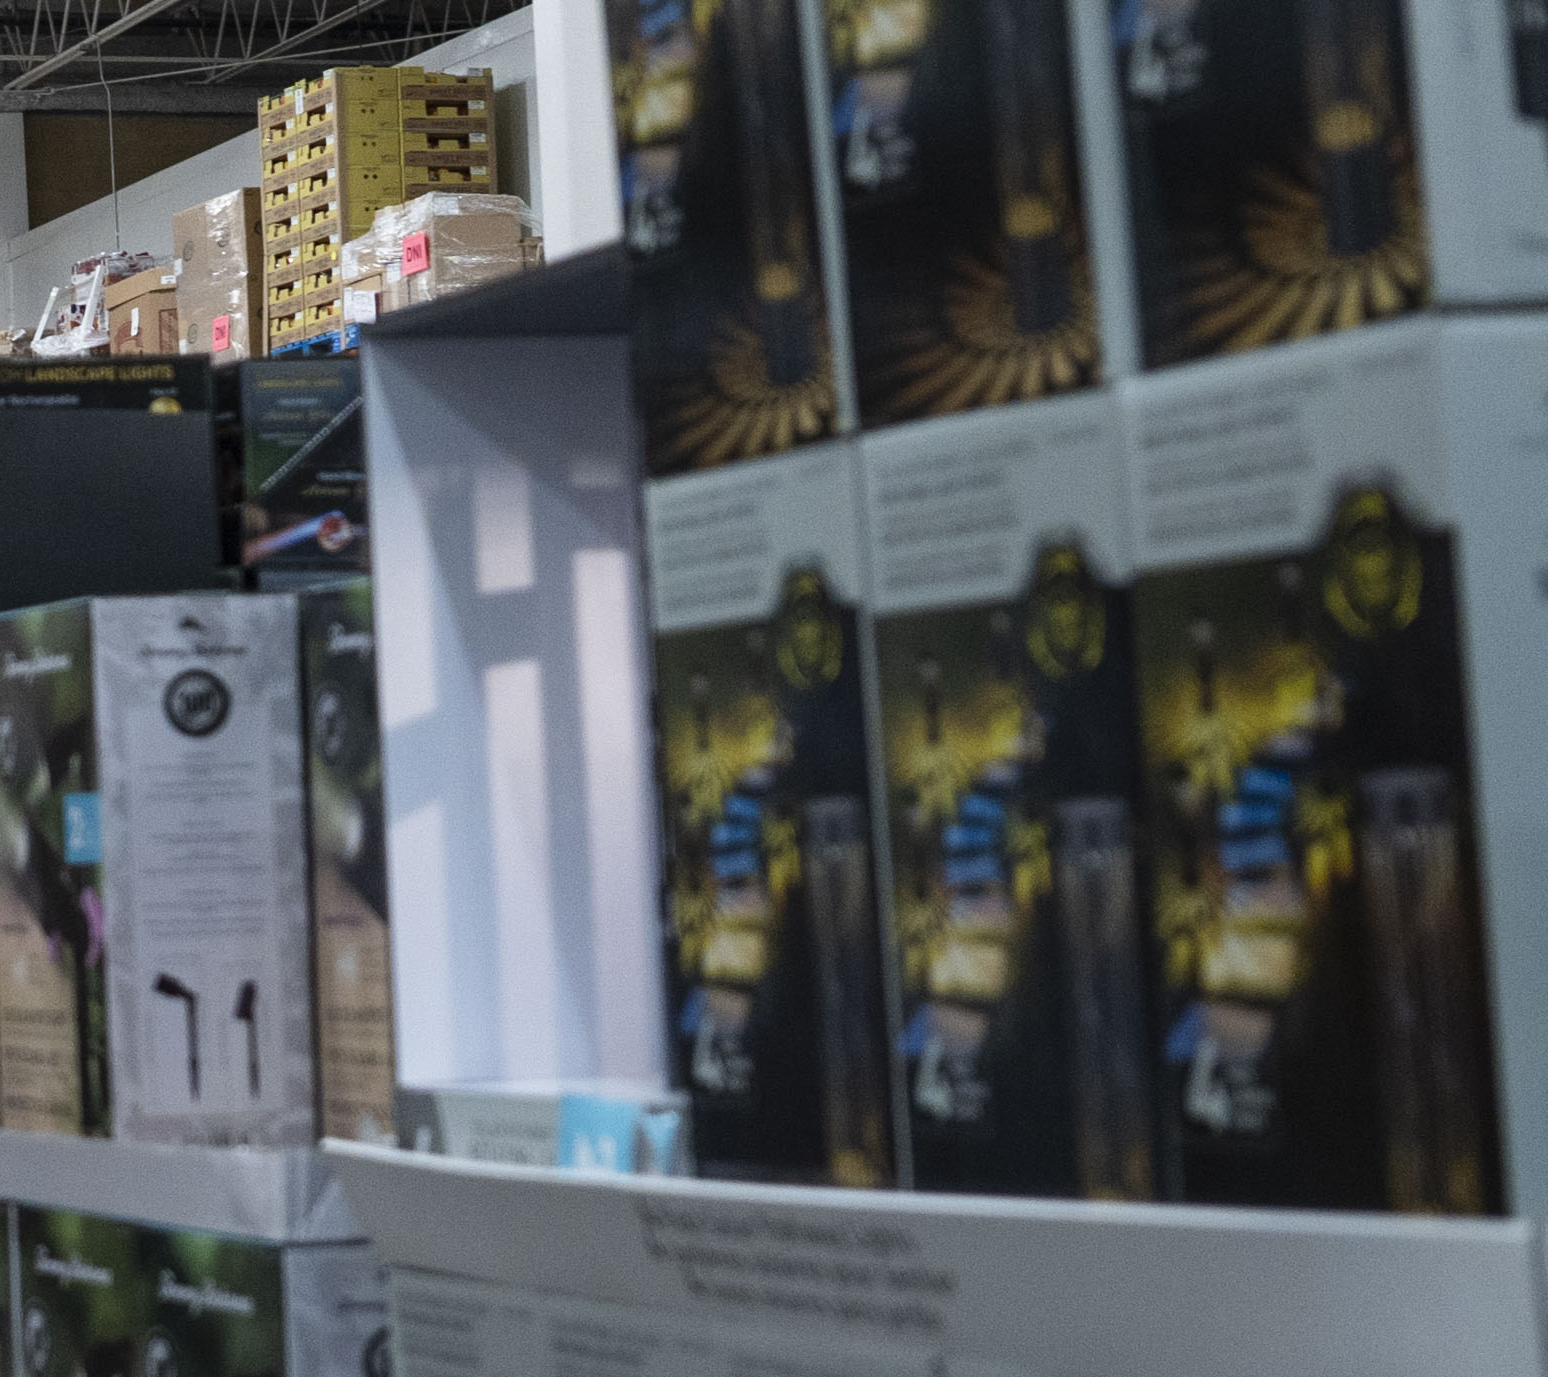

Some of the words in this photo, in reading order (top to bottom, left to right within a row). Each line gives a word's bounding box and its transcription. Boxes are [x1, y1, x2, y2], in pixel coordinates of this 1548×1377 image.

[404, 244, 423, 264] DNI
[25, 365, 115, 383] LANDSCAPE
[119, 364, 175, 381] LIGHTS
